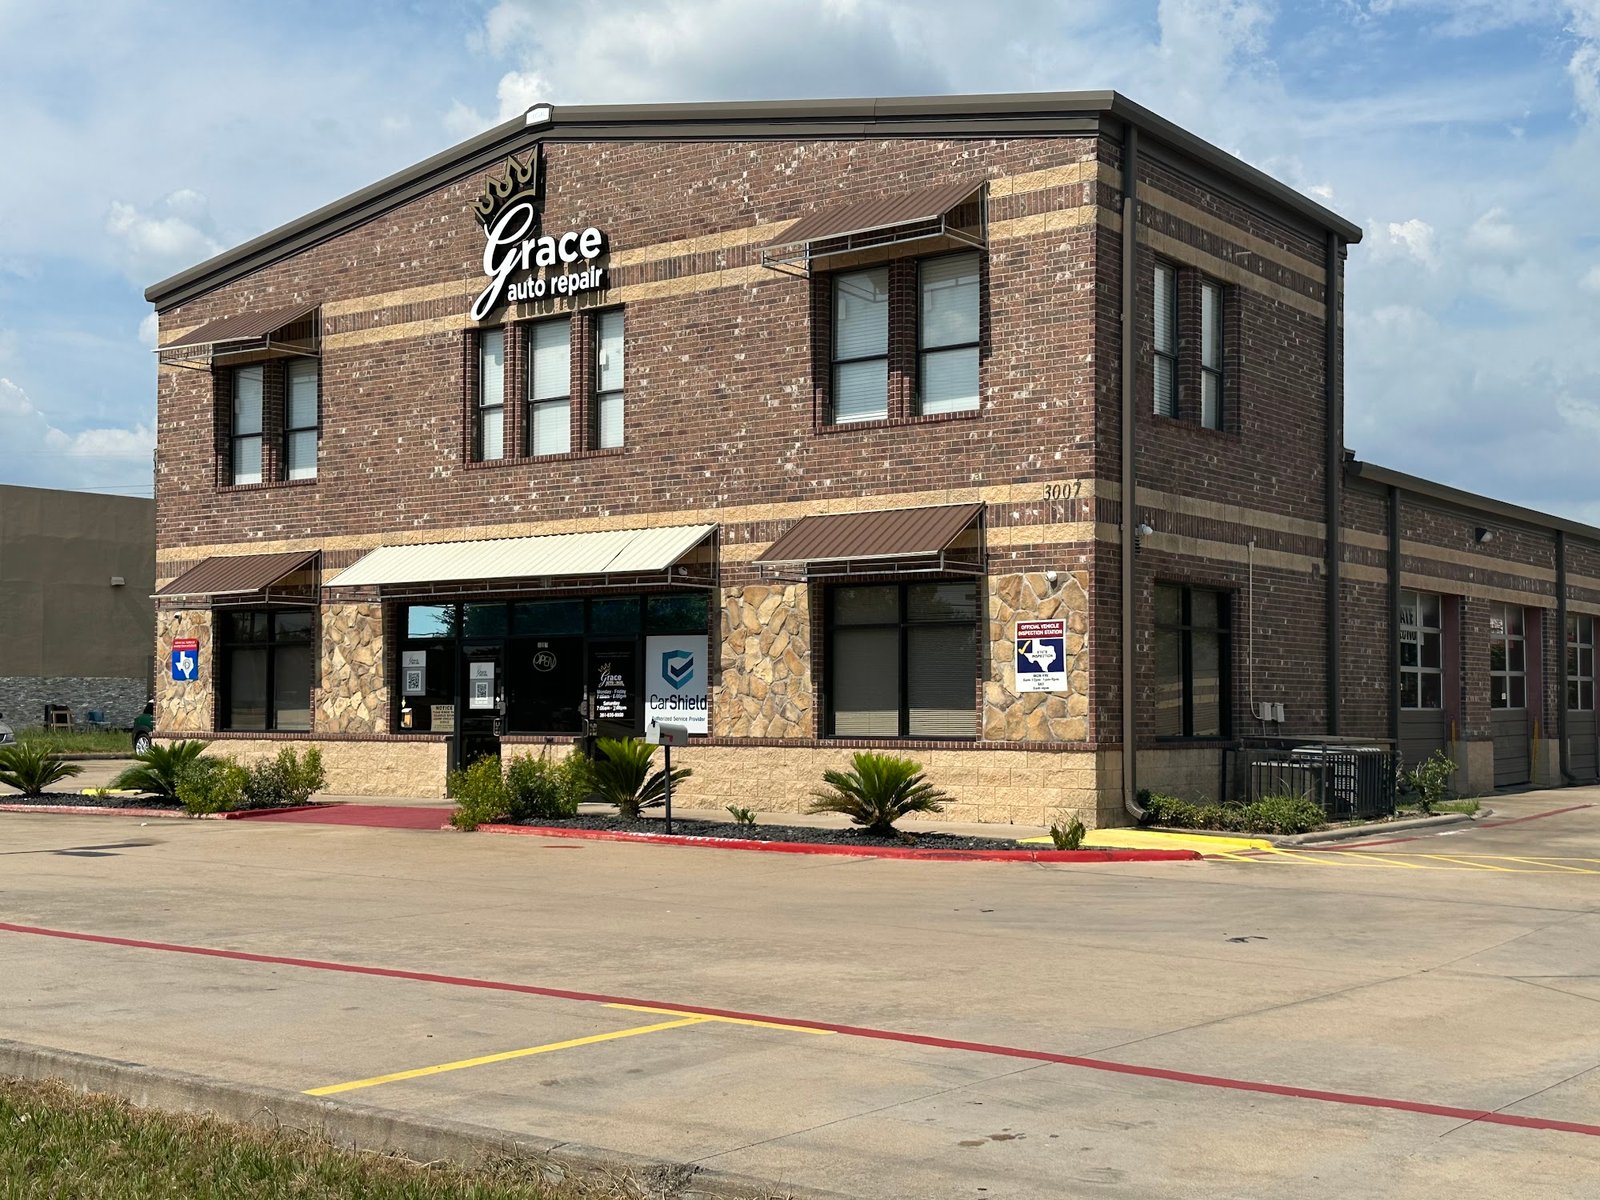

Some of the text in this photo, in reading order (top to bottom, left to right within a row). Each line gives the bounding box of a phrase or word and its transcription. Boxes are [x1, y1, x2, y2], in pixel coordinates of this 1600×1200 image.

[471, 202, 602, 321] Grace
[508, 265, 603, 301] auto repair
[1044, 481, 1081, 500] 3007
[598, 670, 622, 688] Grace
[650, 694, 707, 710] CarShield
